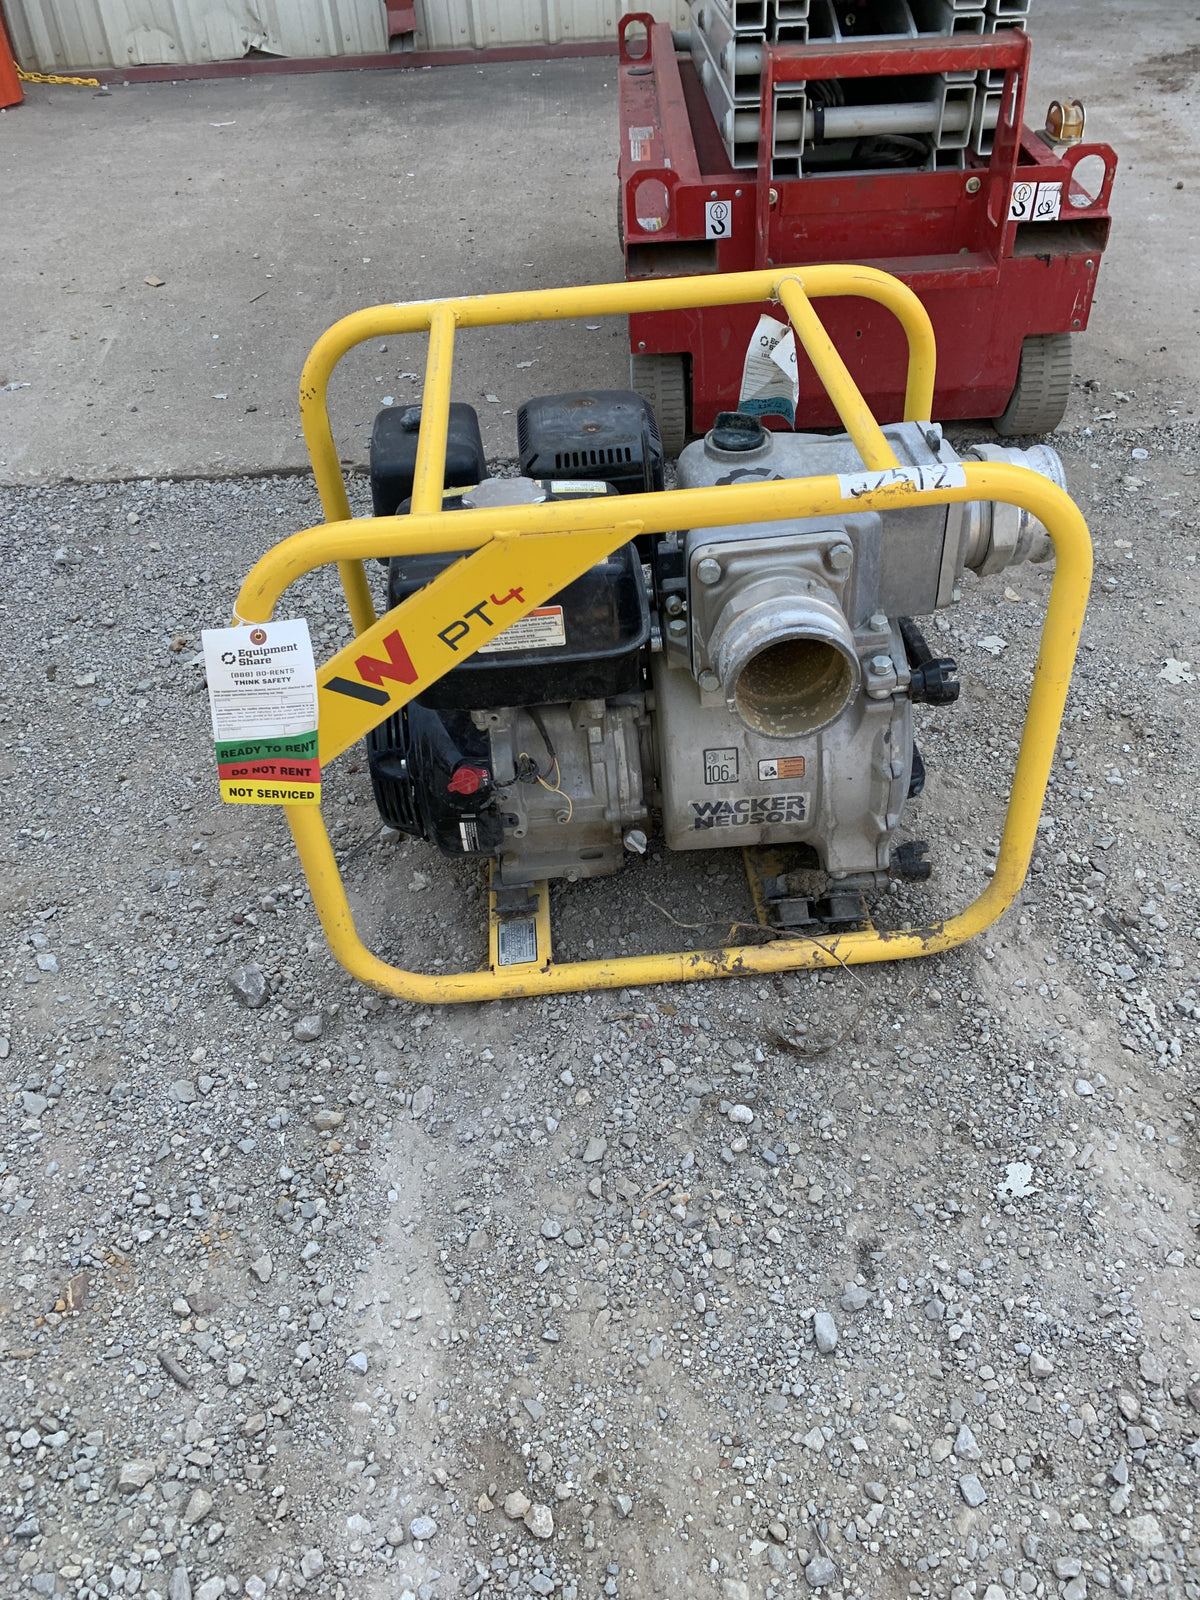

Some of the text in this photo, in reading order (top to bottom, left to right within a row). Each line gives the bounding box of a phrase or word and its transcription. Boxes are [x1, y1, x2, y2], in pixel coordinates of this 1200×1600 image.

[437, 586, 525, 651] PT4
[238, 643, 299, 658] Equipment
[238, 657, 272, 666] Share
[230, 668, 295, 679] (888) 80-RENTS
[220, 740, 316, 758] READY TO RENT
[231, 766, 312, 776] DO NOT RENT
[707, 764, 729, 782] 106
[229, 788, 315, 800] NOT SERVICED
[692, 795, 806, 816] WACKER
[694, 809, 806, 829] NEUSON
